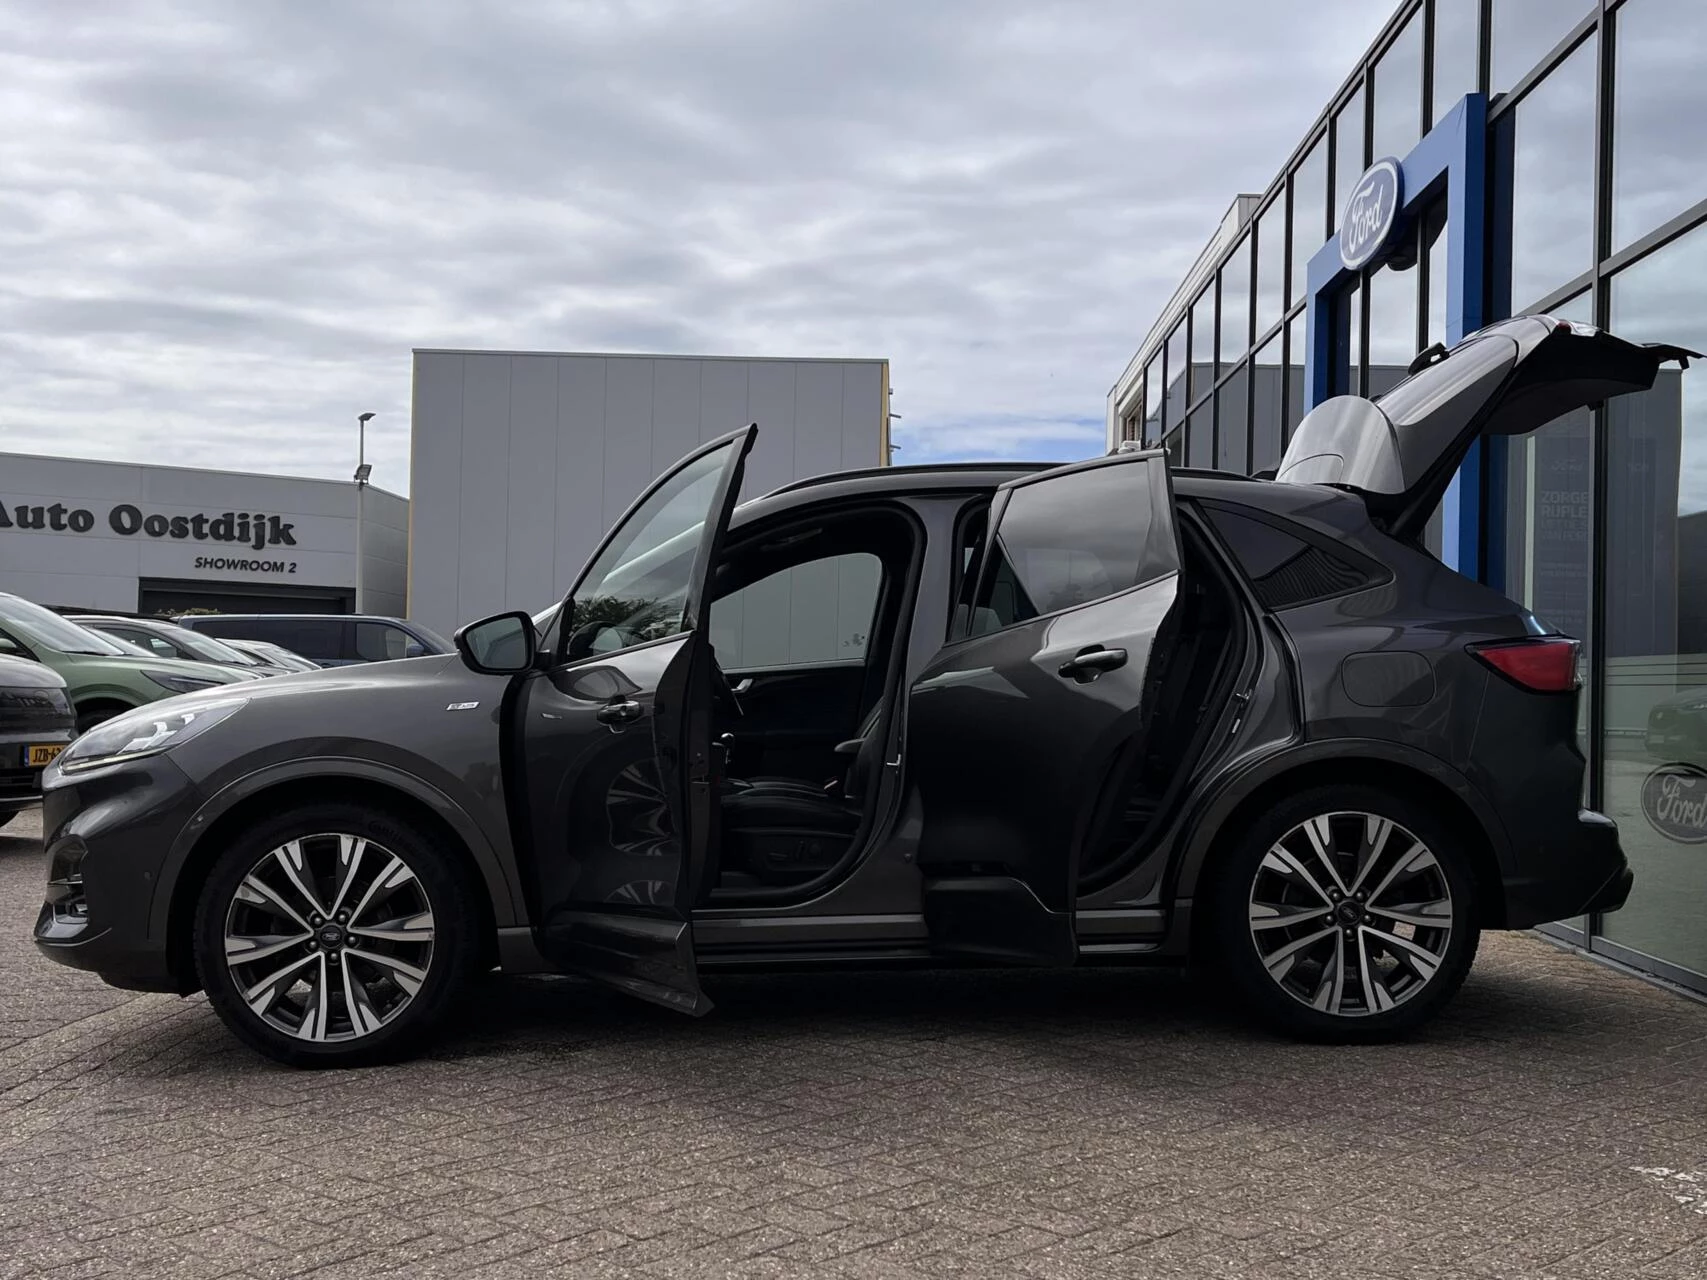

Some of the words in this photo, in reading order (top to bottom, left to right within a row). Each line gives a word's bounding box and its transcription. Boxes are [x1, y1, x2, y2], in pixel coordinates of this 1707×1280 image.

[1349, 181, 1383, 254] Ford
[1540, 491, 1588, 504] ZORGE
[108, 504, 297, 550] Oostdijk
[194, 557, 285, 573] SHOWROOM
[288, 563, 297, 573] 2
[1656, 774, 1707, 828] Ford
